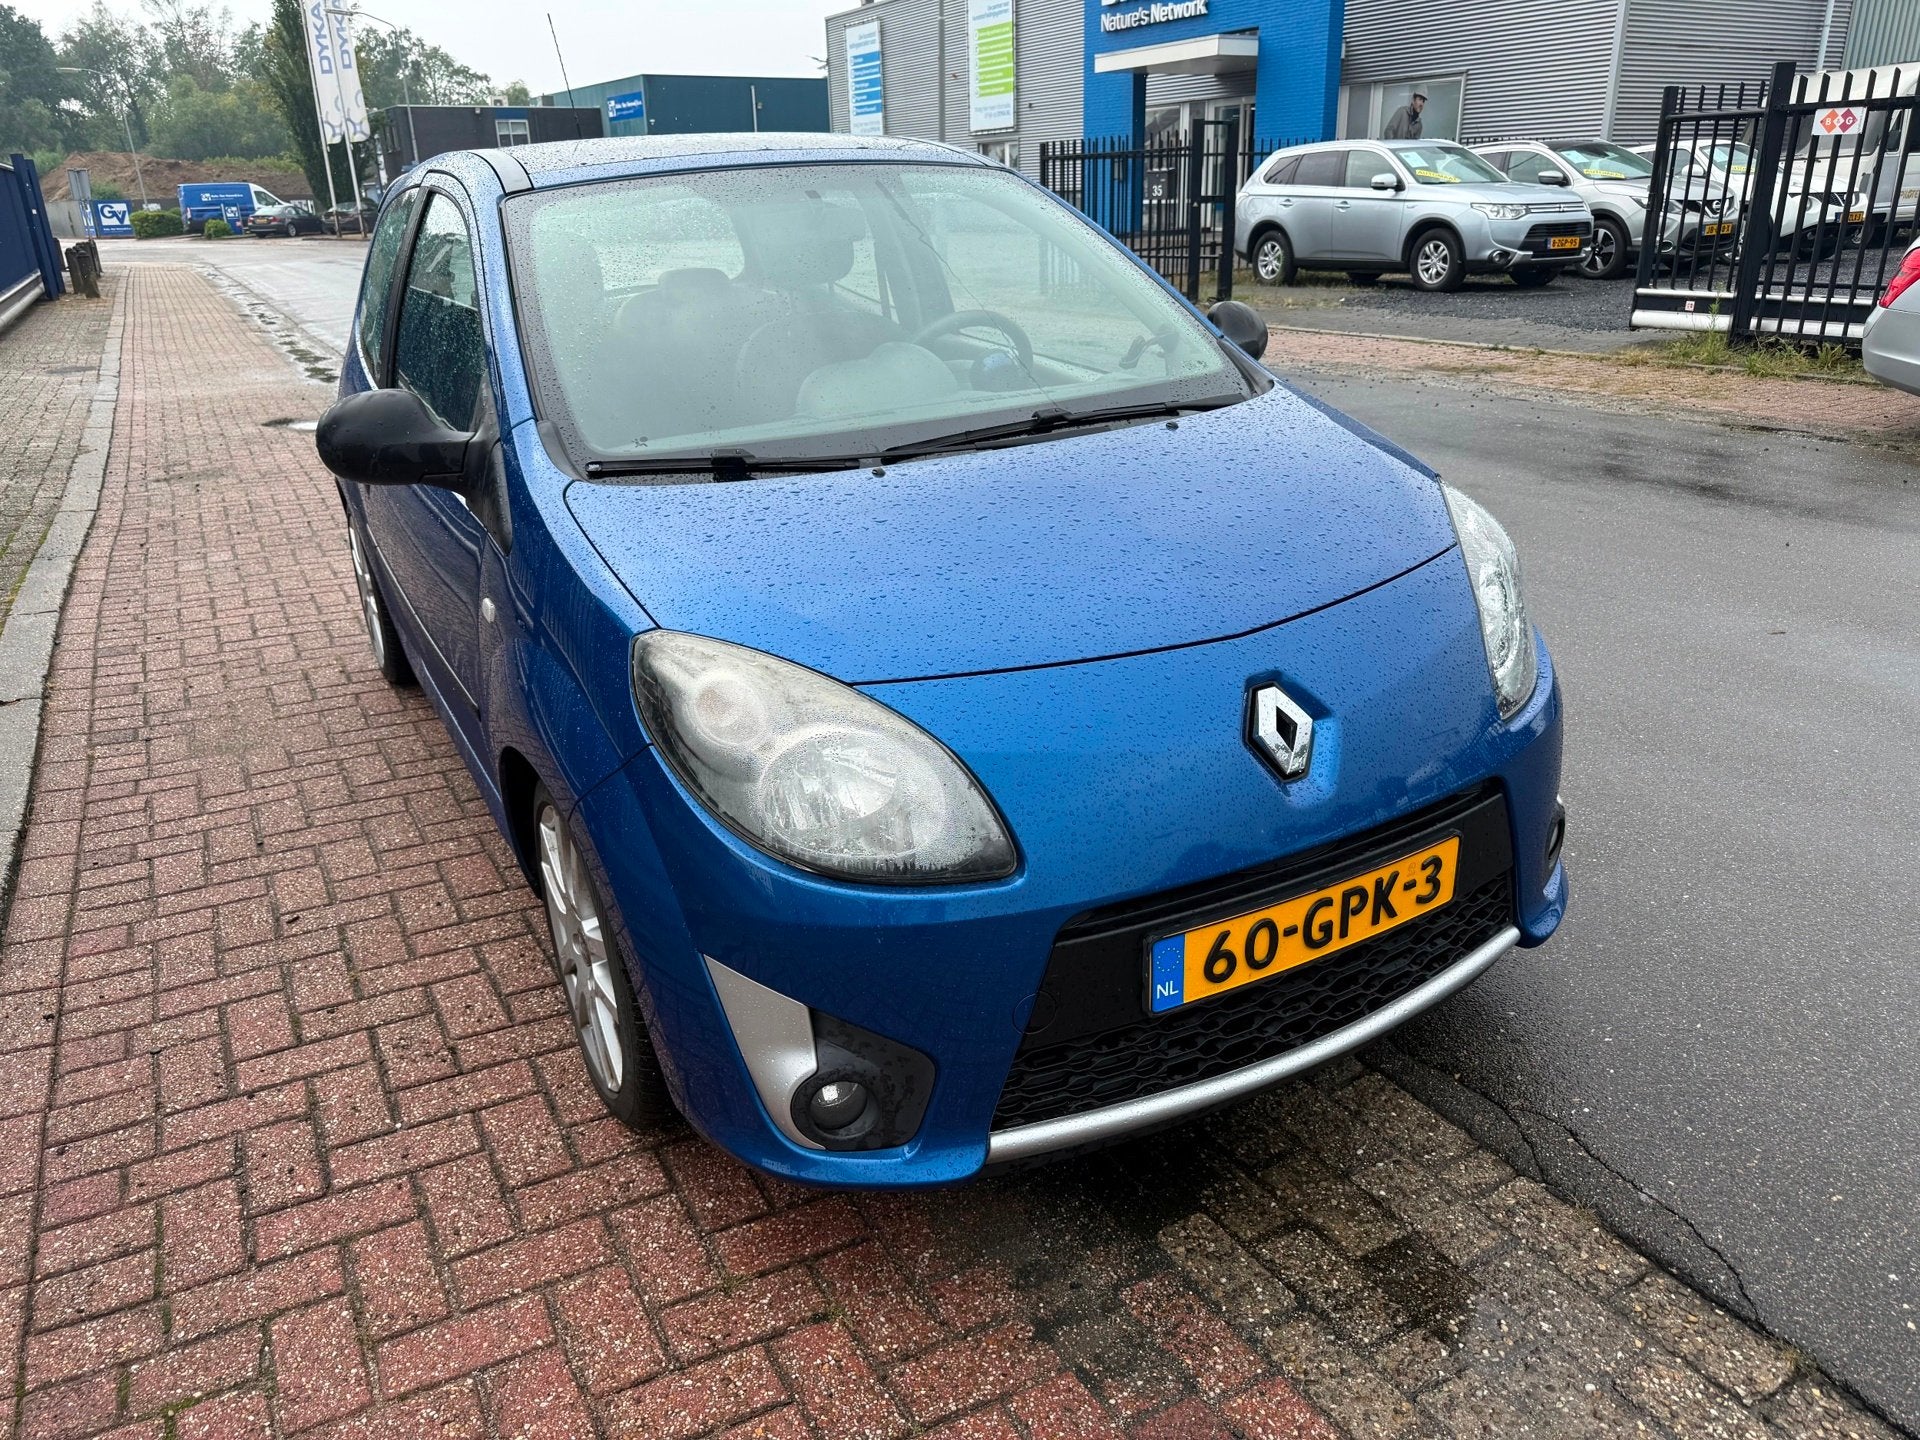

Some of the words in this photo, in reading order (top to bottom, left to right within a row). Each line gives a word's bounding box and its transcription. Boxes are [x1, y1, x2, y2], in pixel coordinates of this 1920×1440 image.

[1101, 7, 1150, 32] Nature's
[1150, 0, 1208, 23] Network
[311, 2, 333, 74] DYKA
[1152, 185, 1163, 197] 35
[100, 204, 128, 225] GV
[1203, 854, 1443, 984] 60-GPK-3
[1157, 980, 1179, 999] NL
